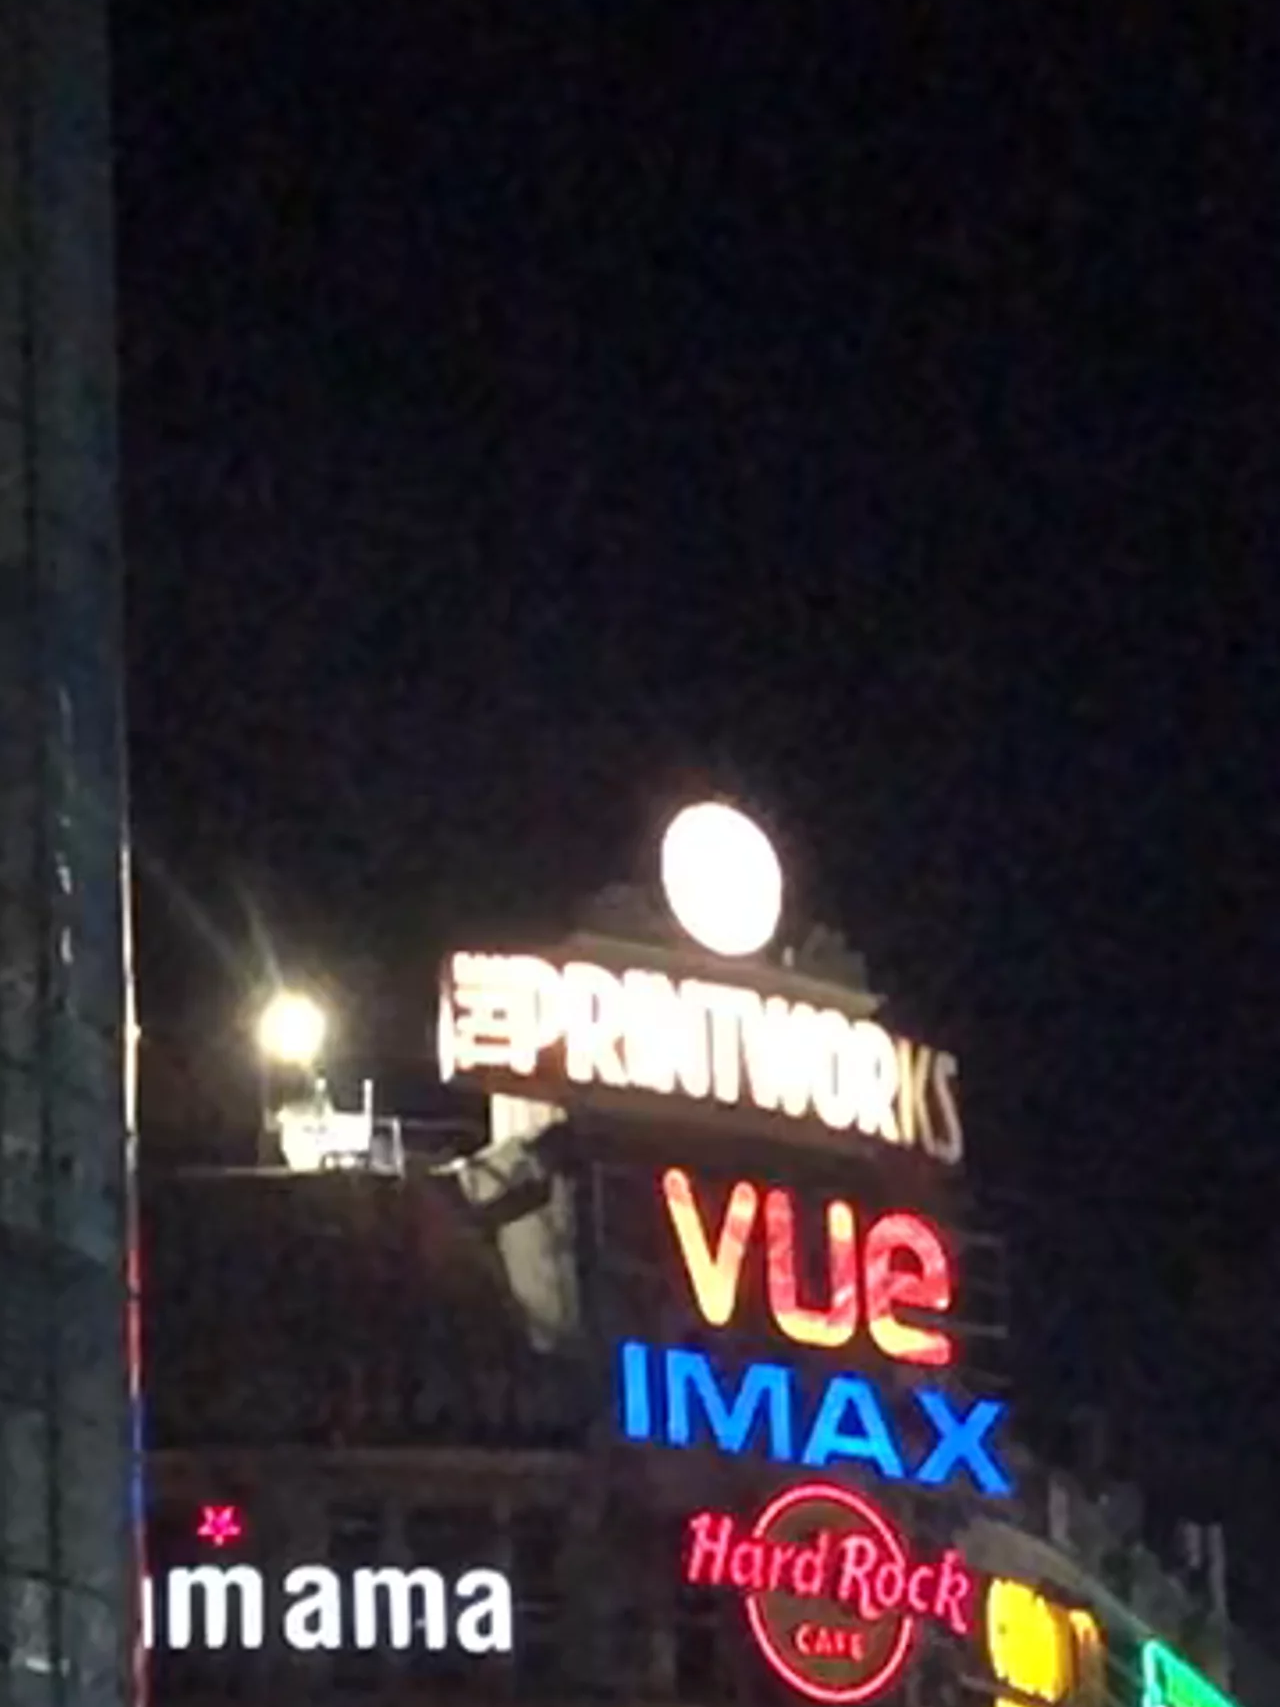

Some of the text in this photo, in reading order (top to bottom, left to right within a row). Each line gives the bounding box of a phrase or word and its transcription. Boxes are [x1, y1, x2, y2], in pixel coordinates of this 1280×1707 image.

[508, 954, 965, 1165] PRINTWORKS
[618, 1340, 1014, 1496] IMAX
[687, 1511, 971, 1634] Hard Rock
